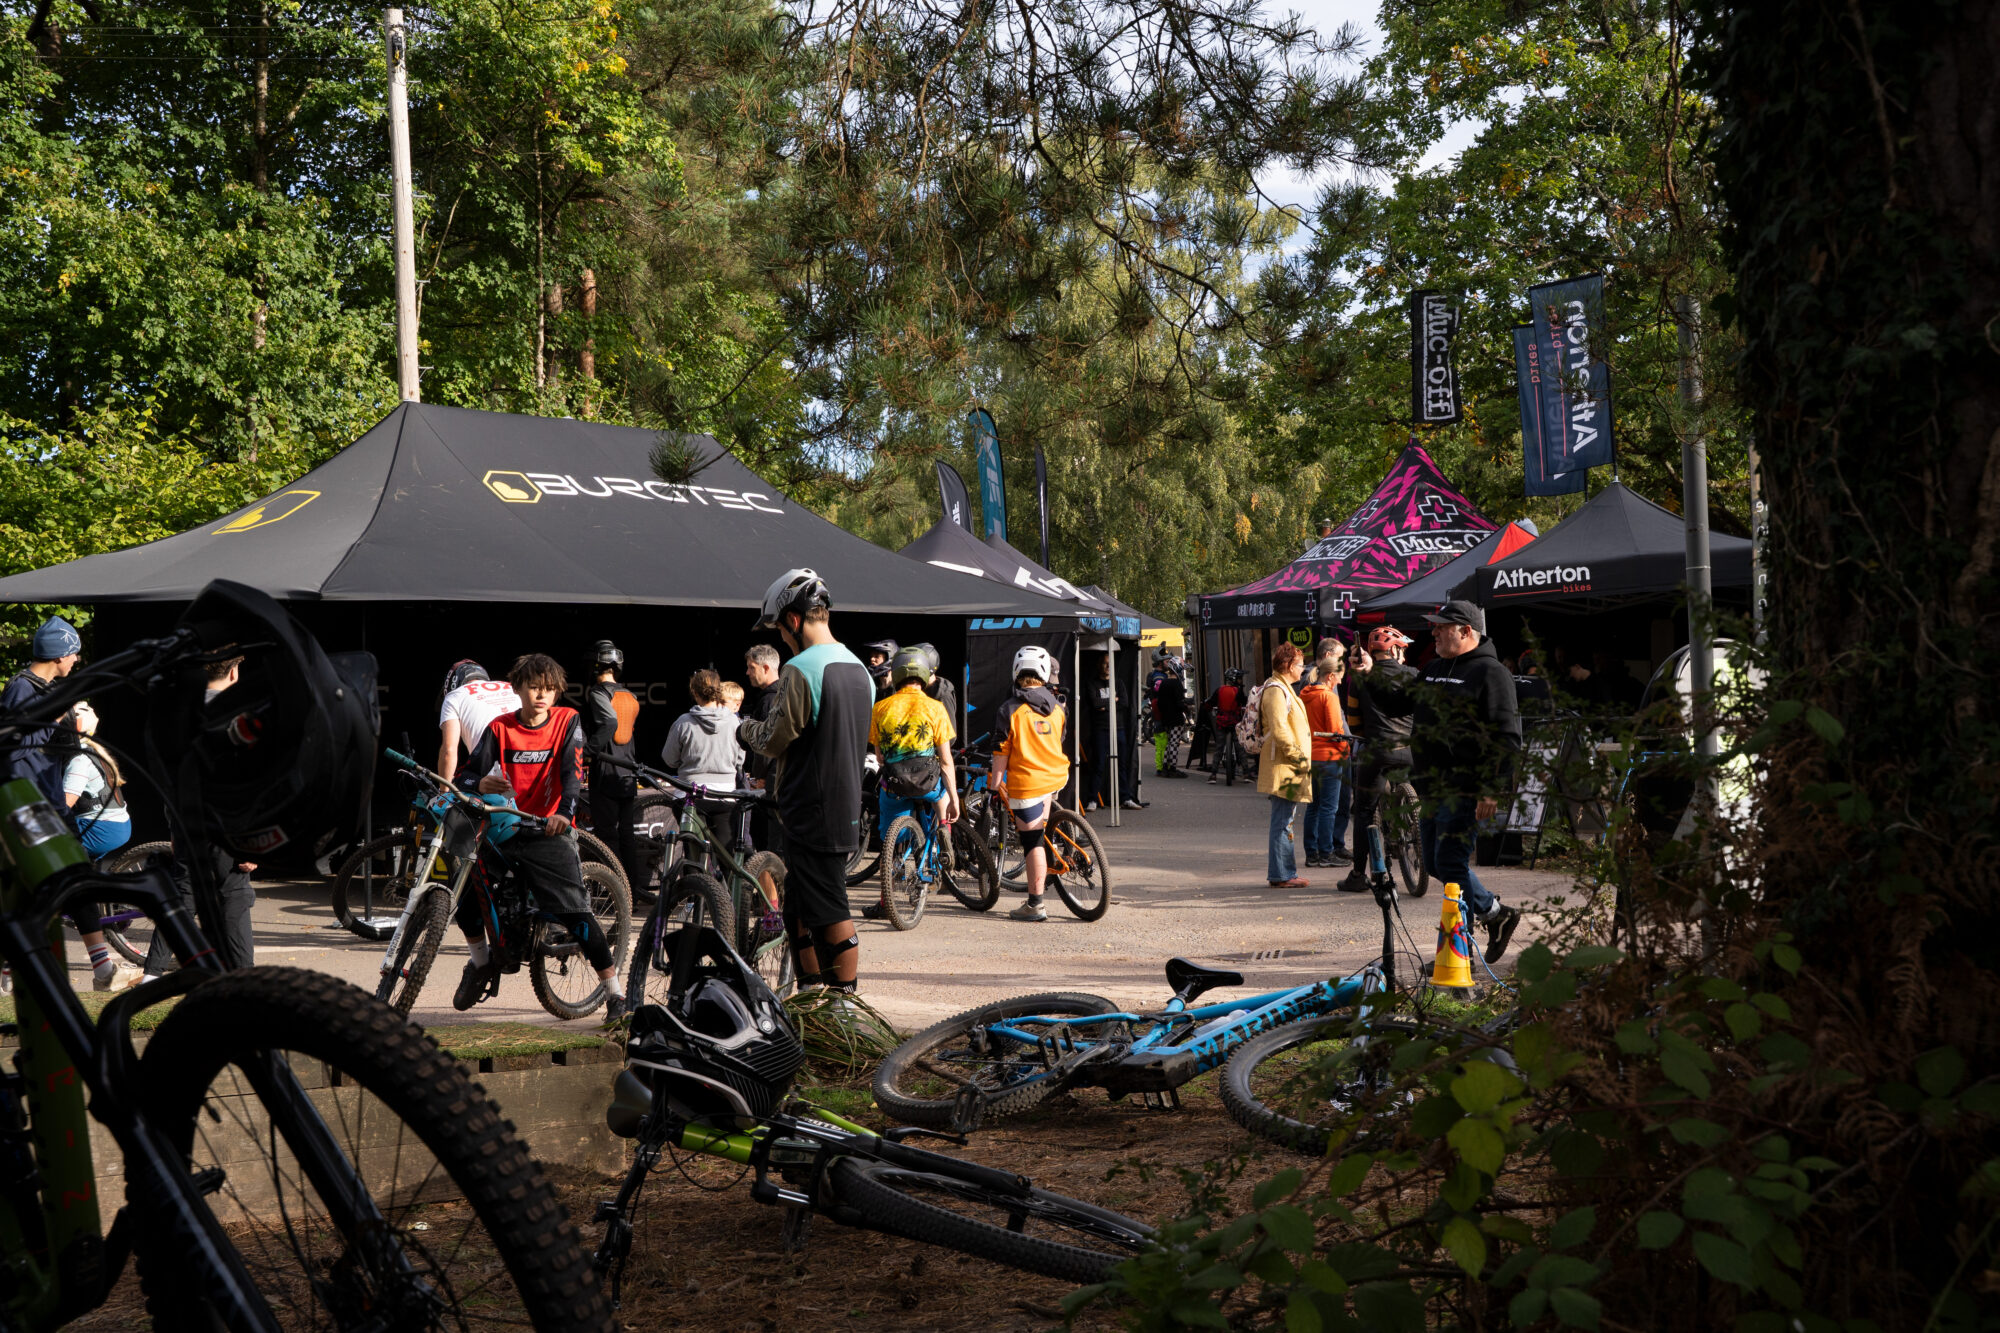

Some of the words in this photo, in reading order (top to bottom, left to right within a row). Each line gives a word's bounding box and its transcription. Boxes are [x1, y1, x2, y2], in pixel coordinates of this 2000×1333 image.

[1396, 532, 1491, 553] Muc-O
[1493, 565, 1591, 590] Atherton
[1563, 584, 1592, 593] bikes
